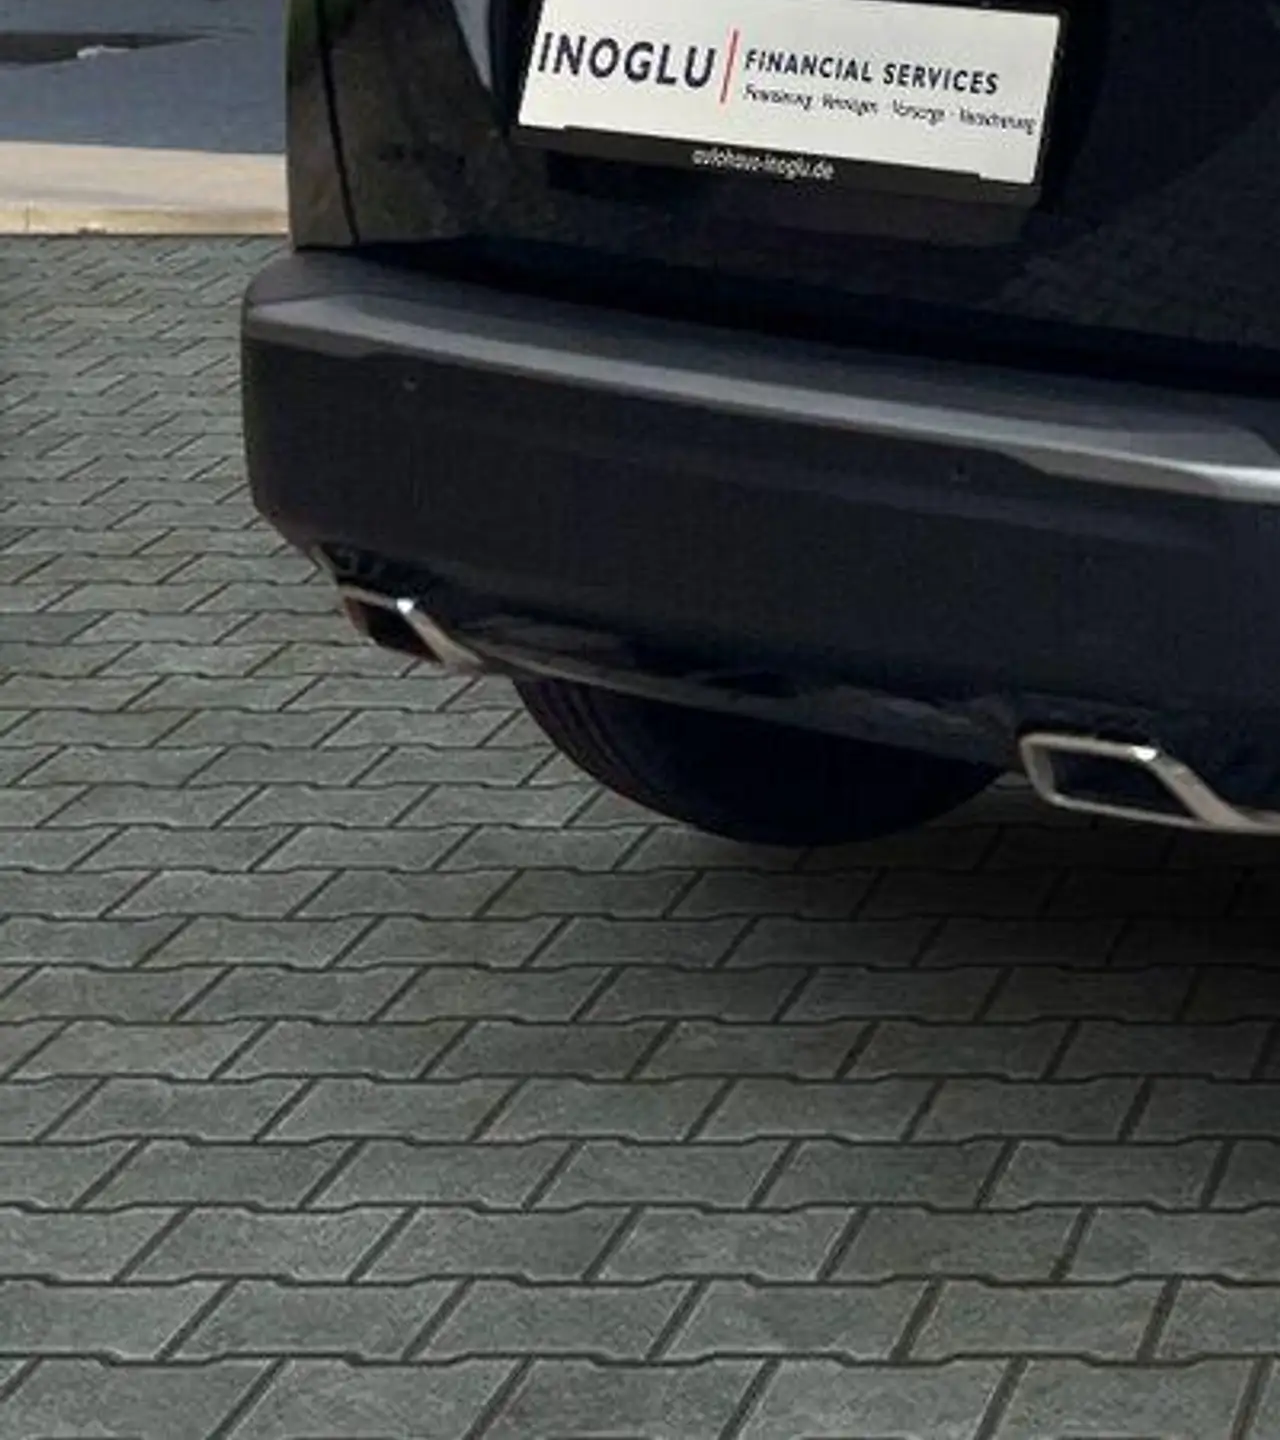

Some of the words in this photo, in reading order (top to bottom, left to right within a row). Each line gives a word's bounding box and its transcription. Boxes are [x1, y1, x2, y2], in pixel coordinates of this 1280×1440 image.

[537, 31, 717, 89] INOGLU
[744, 48, 873, 84] FINANCIAL
[883, 63, 1000, 96] SERVICES
